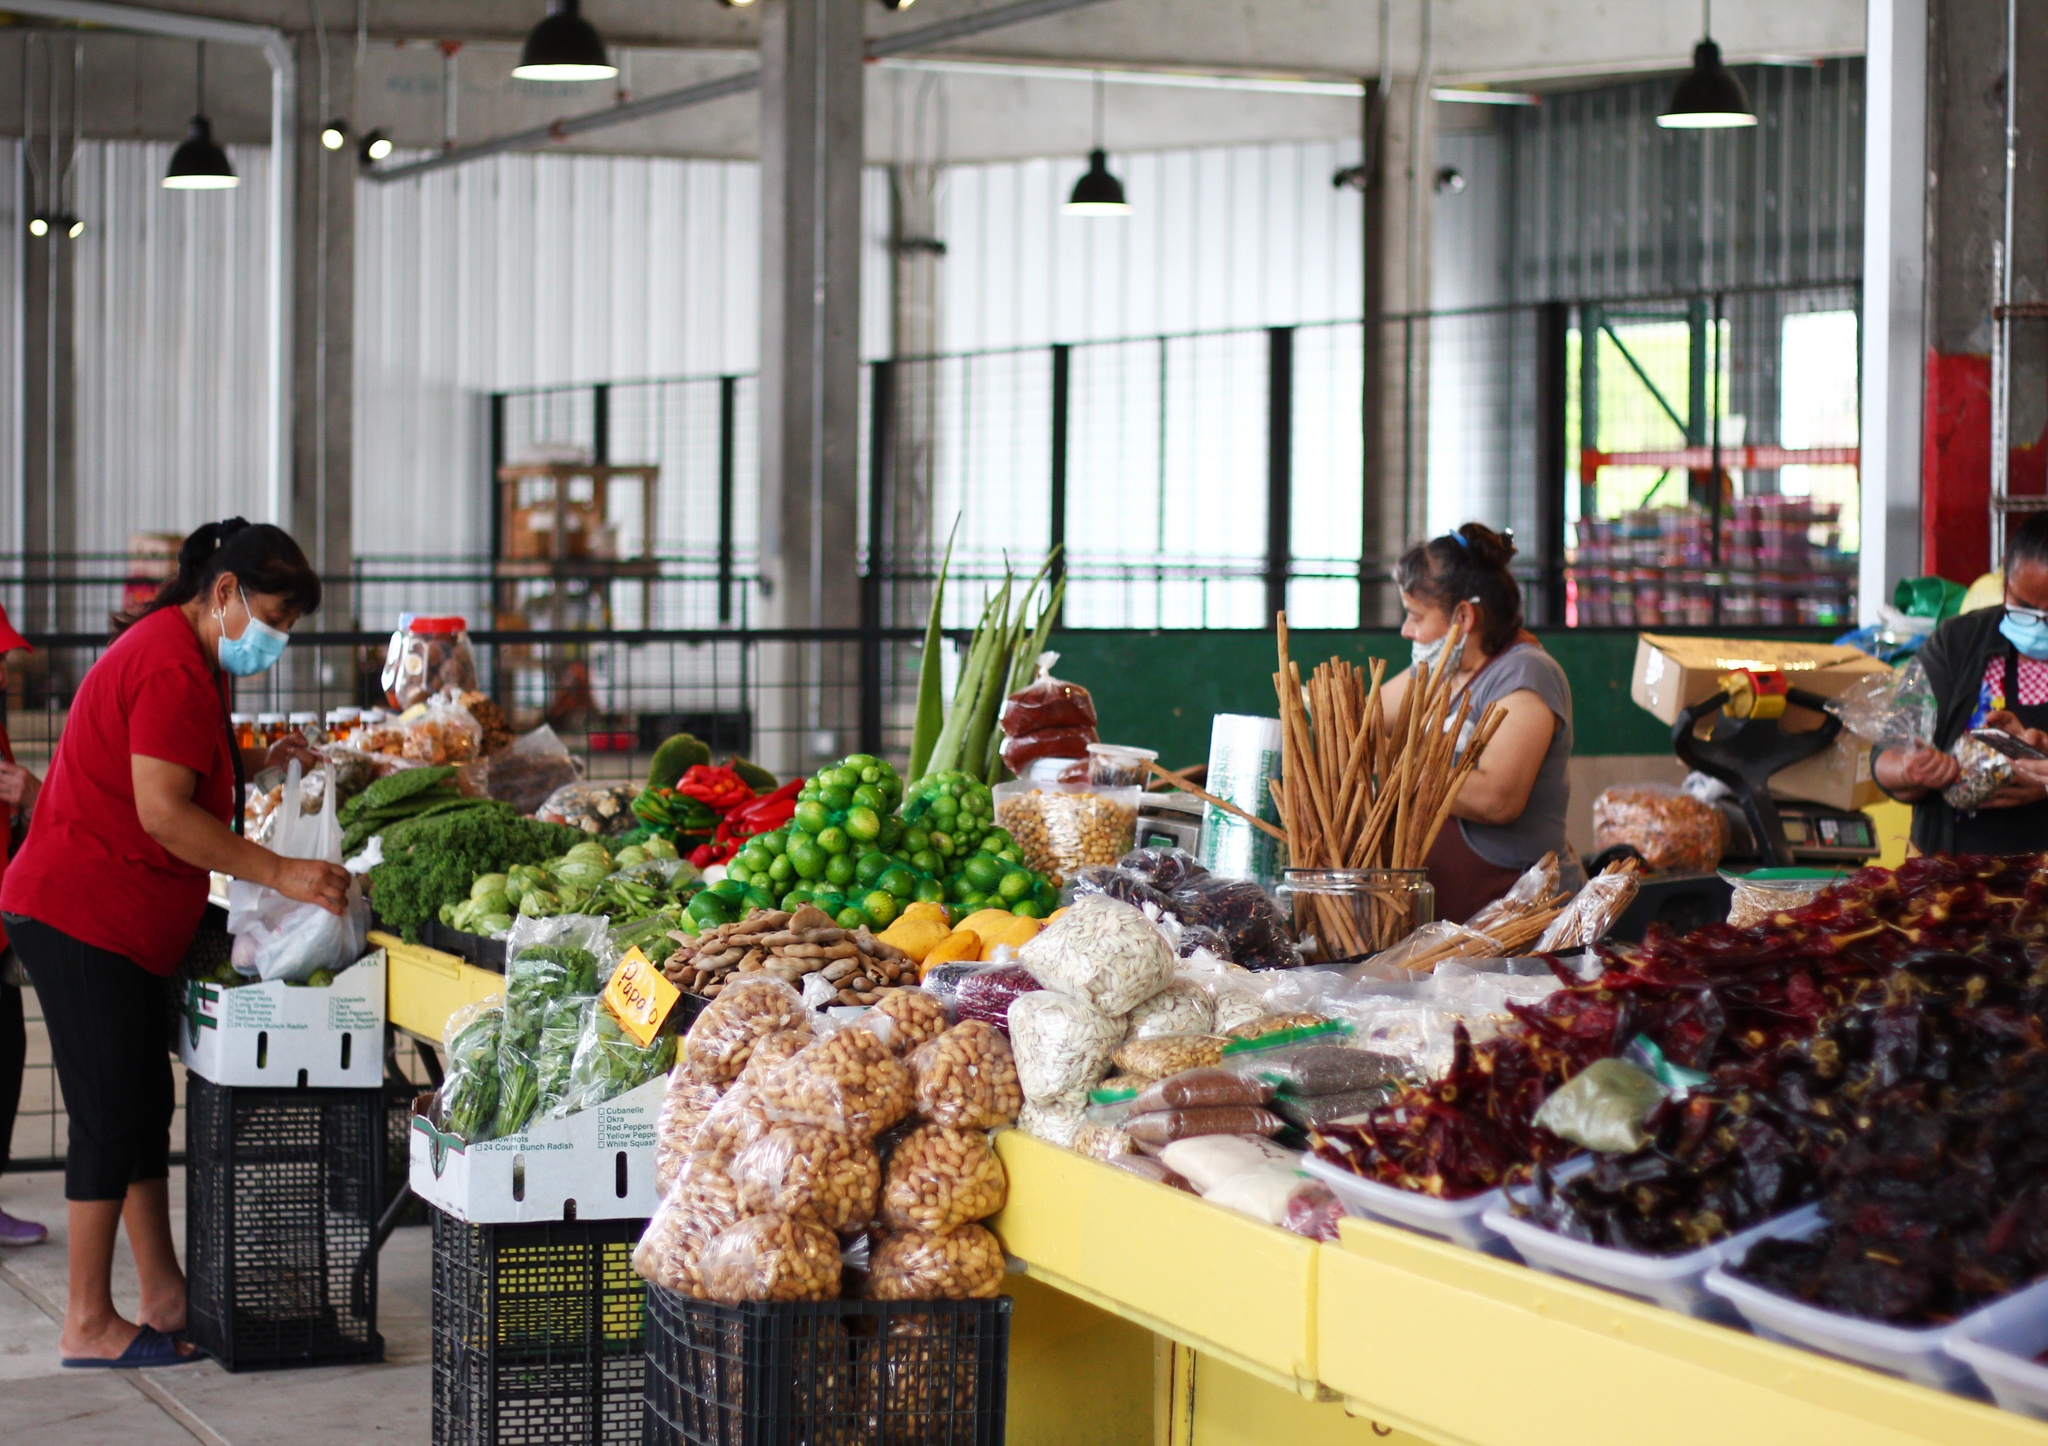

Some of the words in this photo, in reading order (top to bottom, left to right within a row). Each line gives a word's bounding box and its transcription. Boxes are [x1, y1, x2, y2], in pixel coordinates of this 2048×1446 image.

[606, 1107, 645, 1115] Cubanelle
[623, 1123, 655, 1132] Peppers
[511, 1135, 529, 1143] Hots
[606, 1132, 631, 1140] Yellow
[633, 1131, 658, 1139] Peppe
[495, 1143, 519, 1151] Count
[520, 1143, 546, 1151] Bunch
[547, 1142, 574, 1150] Radish
[606, 1140, 629, 1148] White
